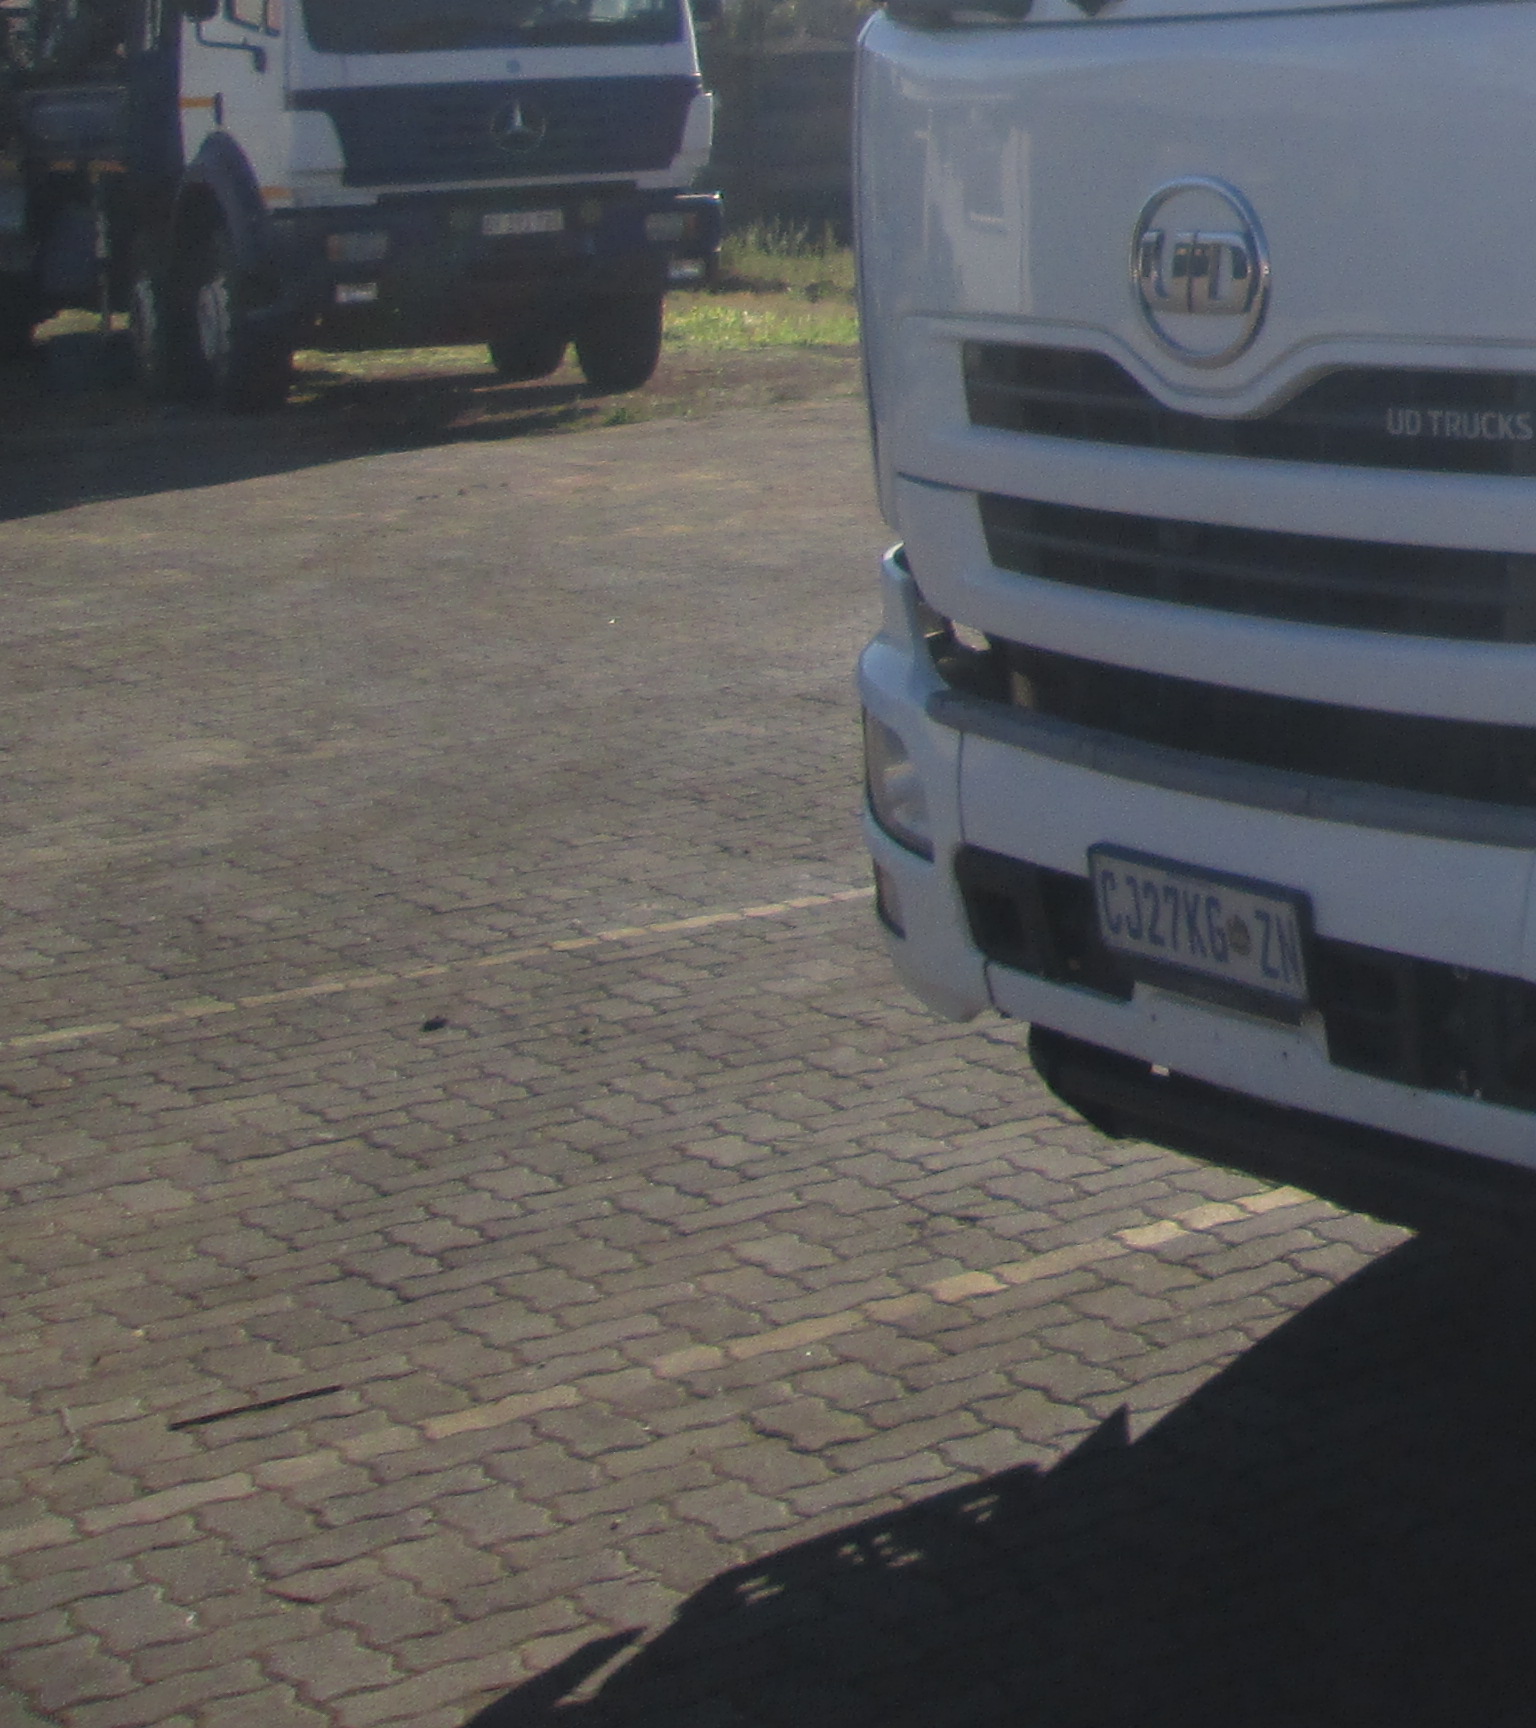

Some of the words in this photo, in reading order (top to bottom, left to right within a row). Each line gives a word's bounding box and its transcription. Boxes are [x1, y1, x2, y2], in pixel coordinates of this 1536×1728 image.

[1139, 229, 1258, 317] UD
[1386, 408, 1421, 436] UD
[1427, 409, 1535, 441] TRUCKS
[1101, 868, 1230, 964] CJ27KG
[1254, 908, 1302, 985] ZN
